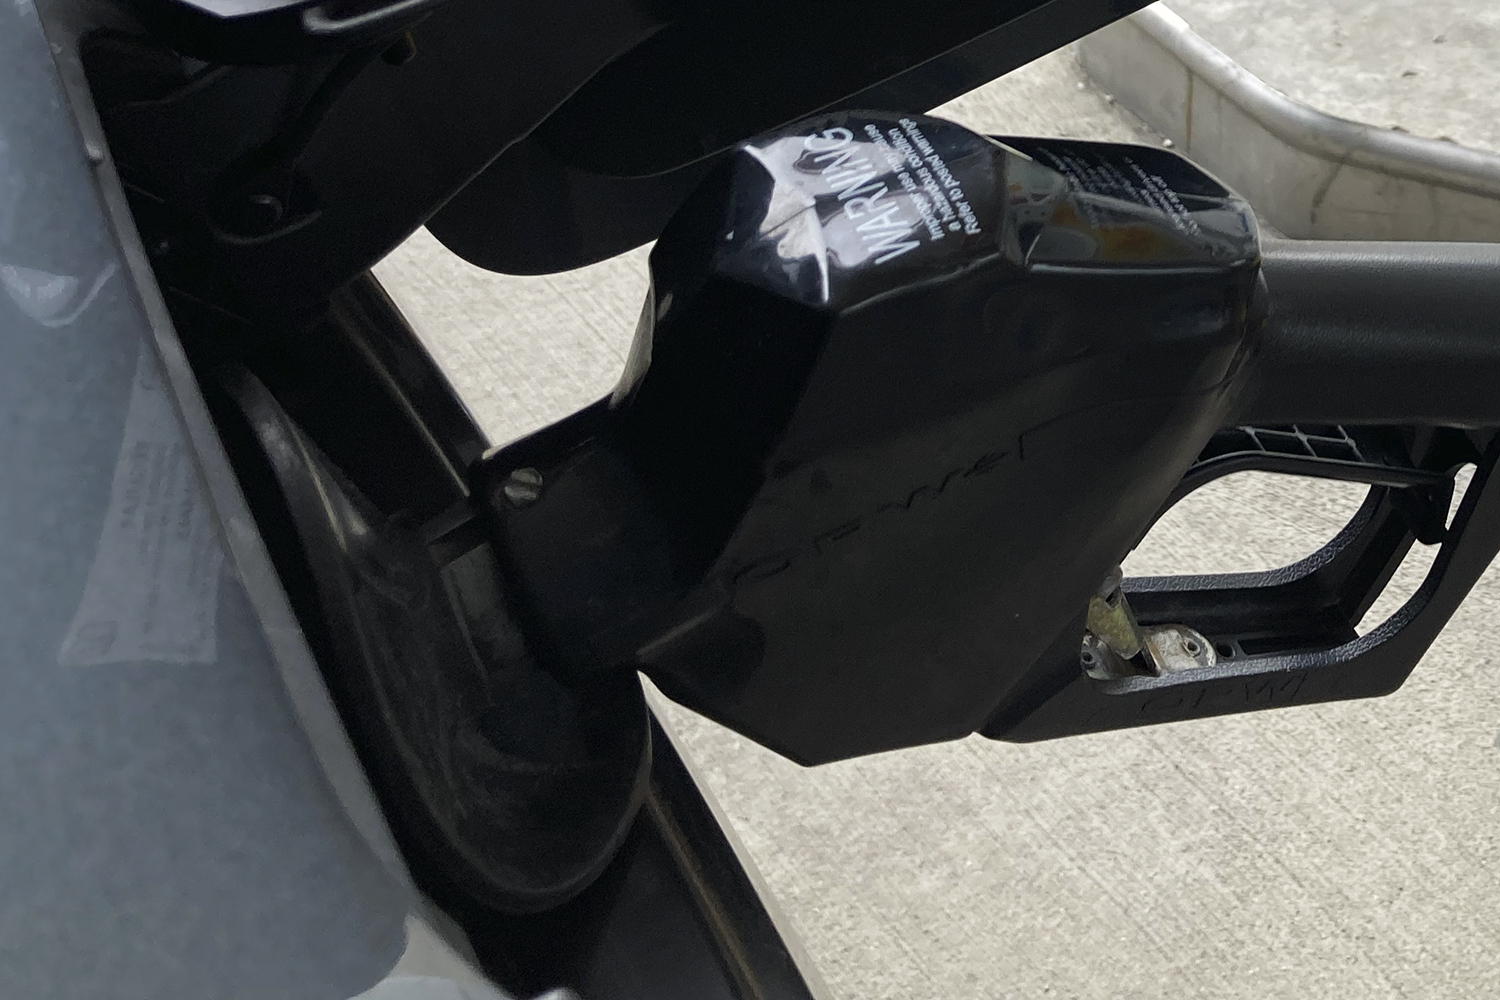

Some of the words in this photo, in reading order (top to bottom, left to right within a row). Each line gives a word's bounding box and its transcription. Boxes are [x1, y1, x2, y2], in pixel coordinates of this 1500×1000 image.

[888, 127, 924, 168] condition
[898, 117, 935, 156] warnings
[897, 171, 917, 192] use
[924, 153, 961, 189] posted
[804, 126, 921, 265] WARNING
[916, 166, 957, 223] hazardous
[948, 187, 964, 202] to
[910, 192, 946, 242] Improper
[948, 220, 962, 232] a
[955, 200, 982, 235] Refer
